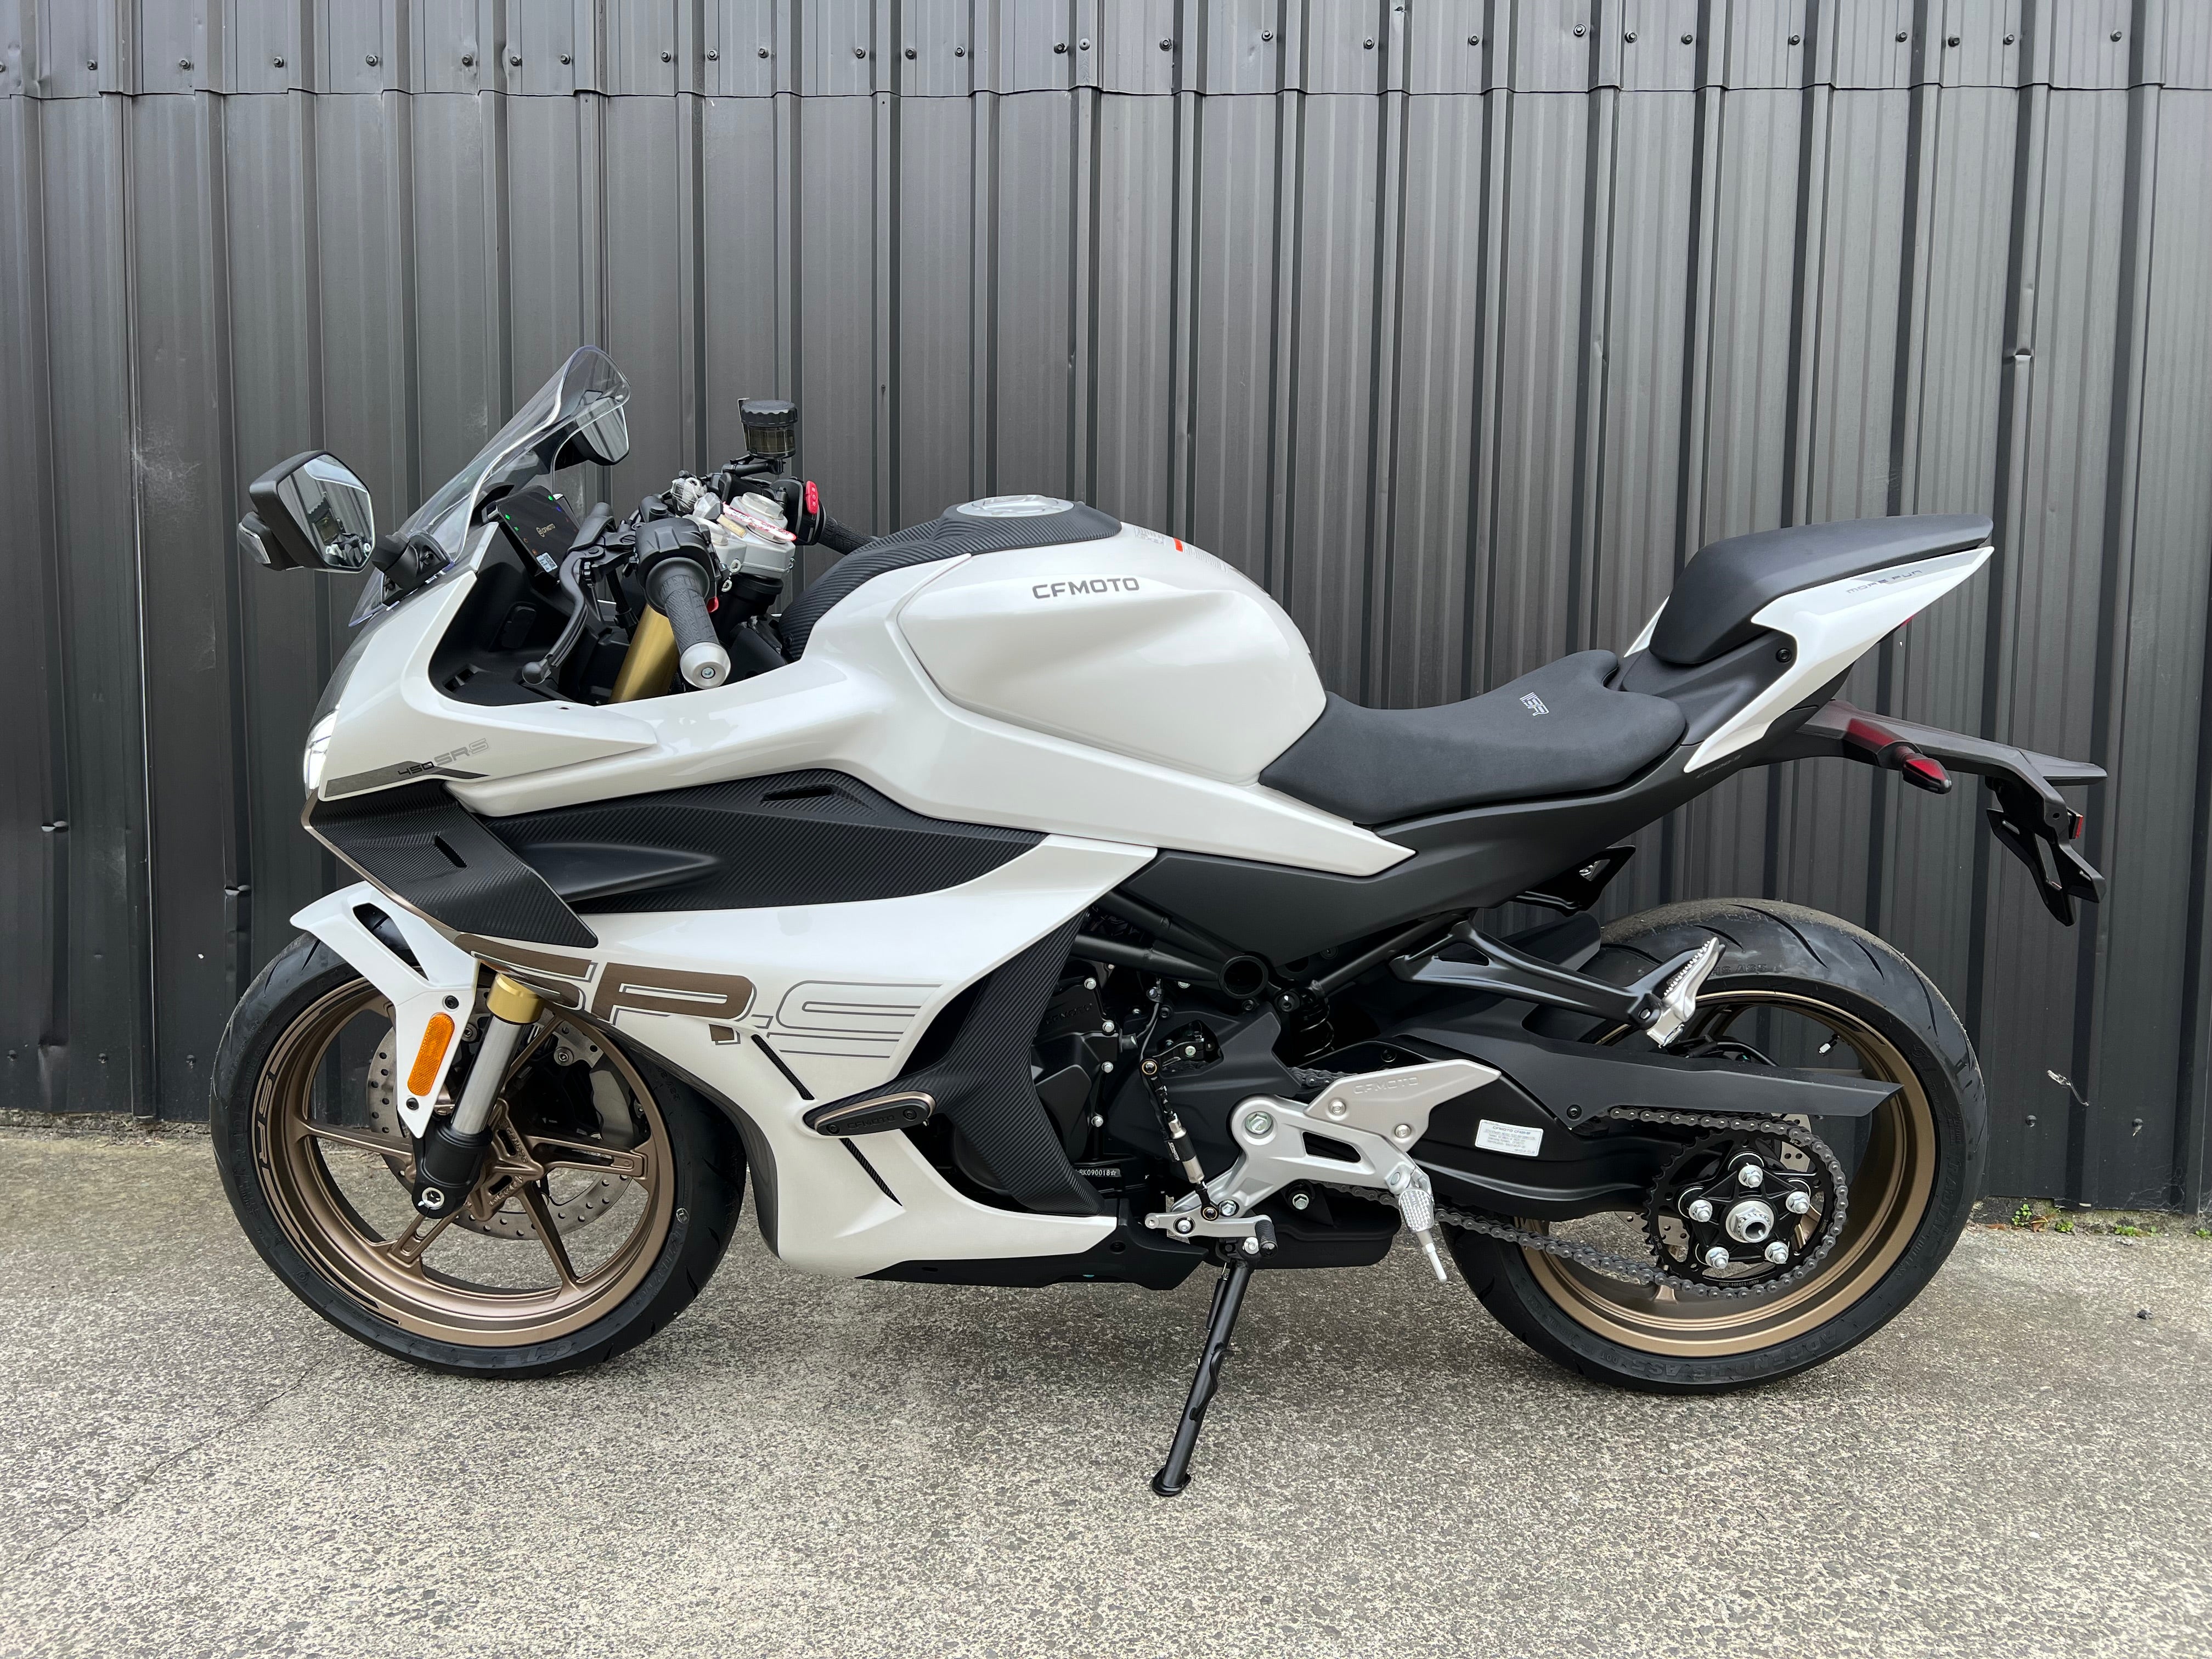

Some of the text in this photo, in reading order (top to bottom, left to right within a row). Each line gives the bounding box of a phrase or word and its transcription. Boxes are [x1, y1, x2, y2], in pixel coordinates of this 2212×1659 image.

[1032, 578, 1140, 599] CFMOTO
[1847, 569, 1923, 594] MORE FUN
[1353, 1077, 1419, 1094] CFMOTO
[847, 1115, 896, 1131] CFMOTO
[1601, 1352, 1618, 1364] DOT
[1632, 1359, 1681, 1376] AS5
